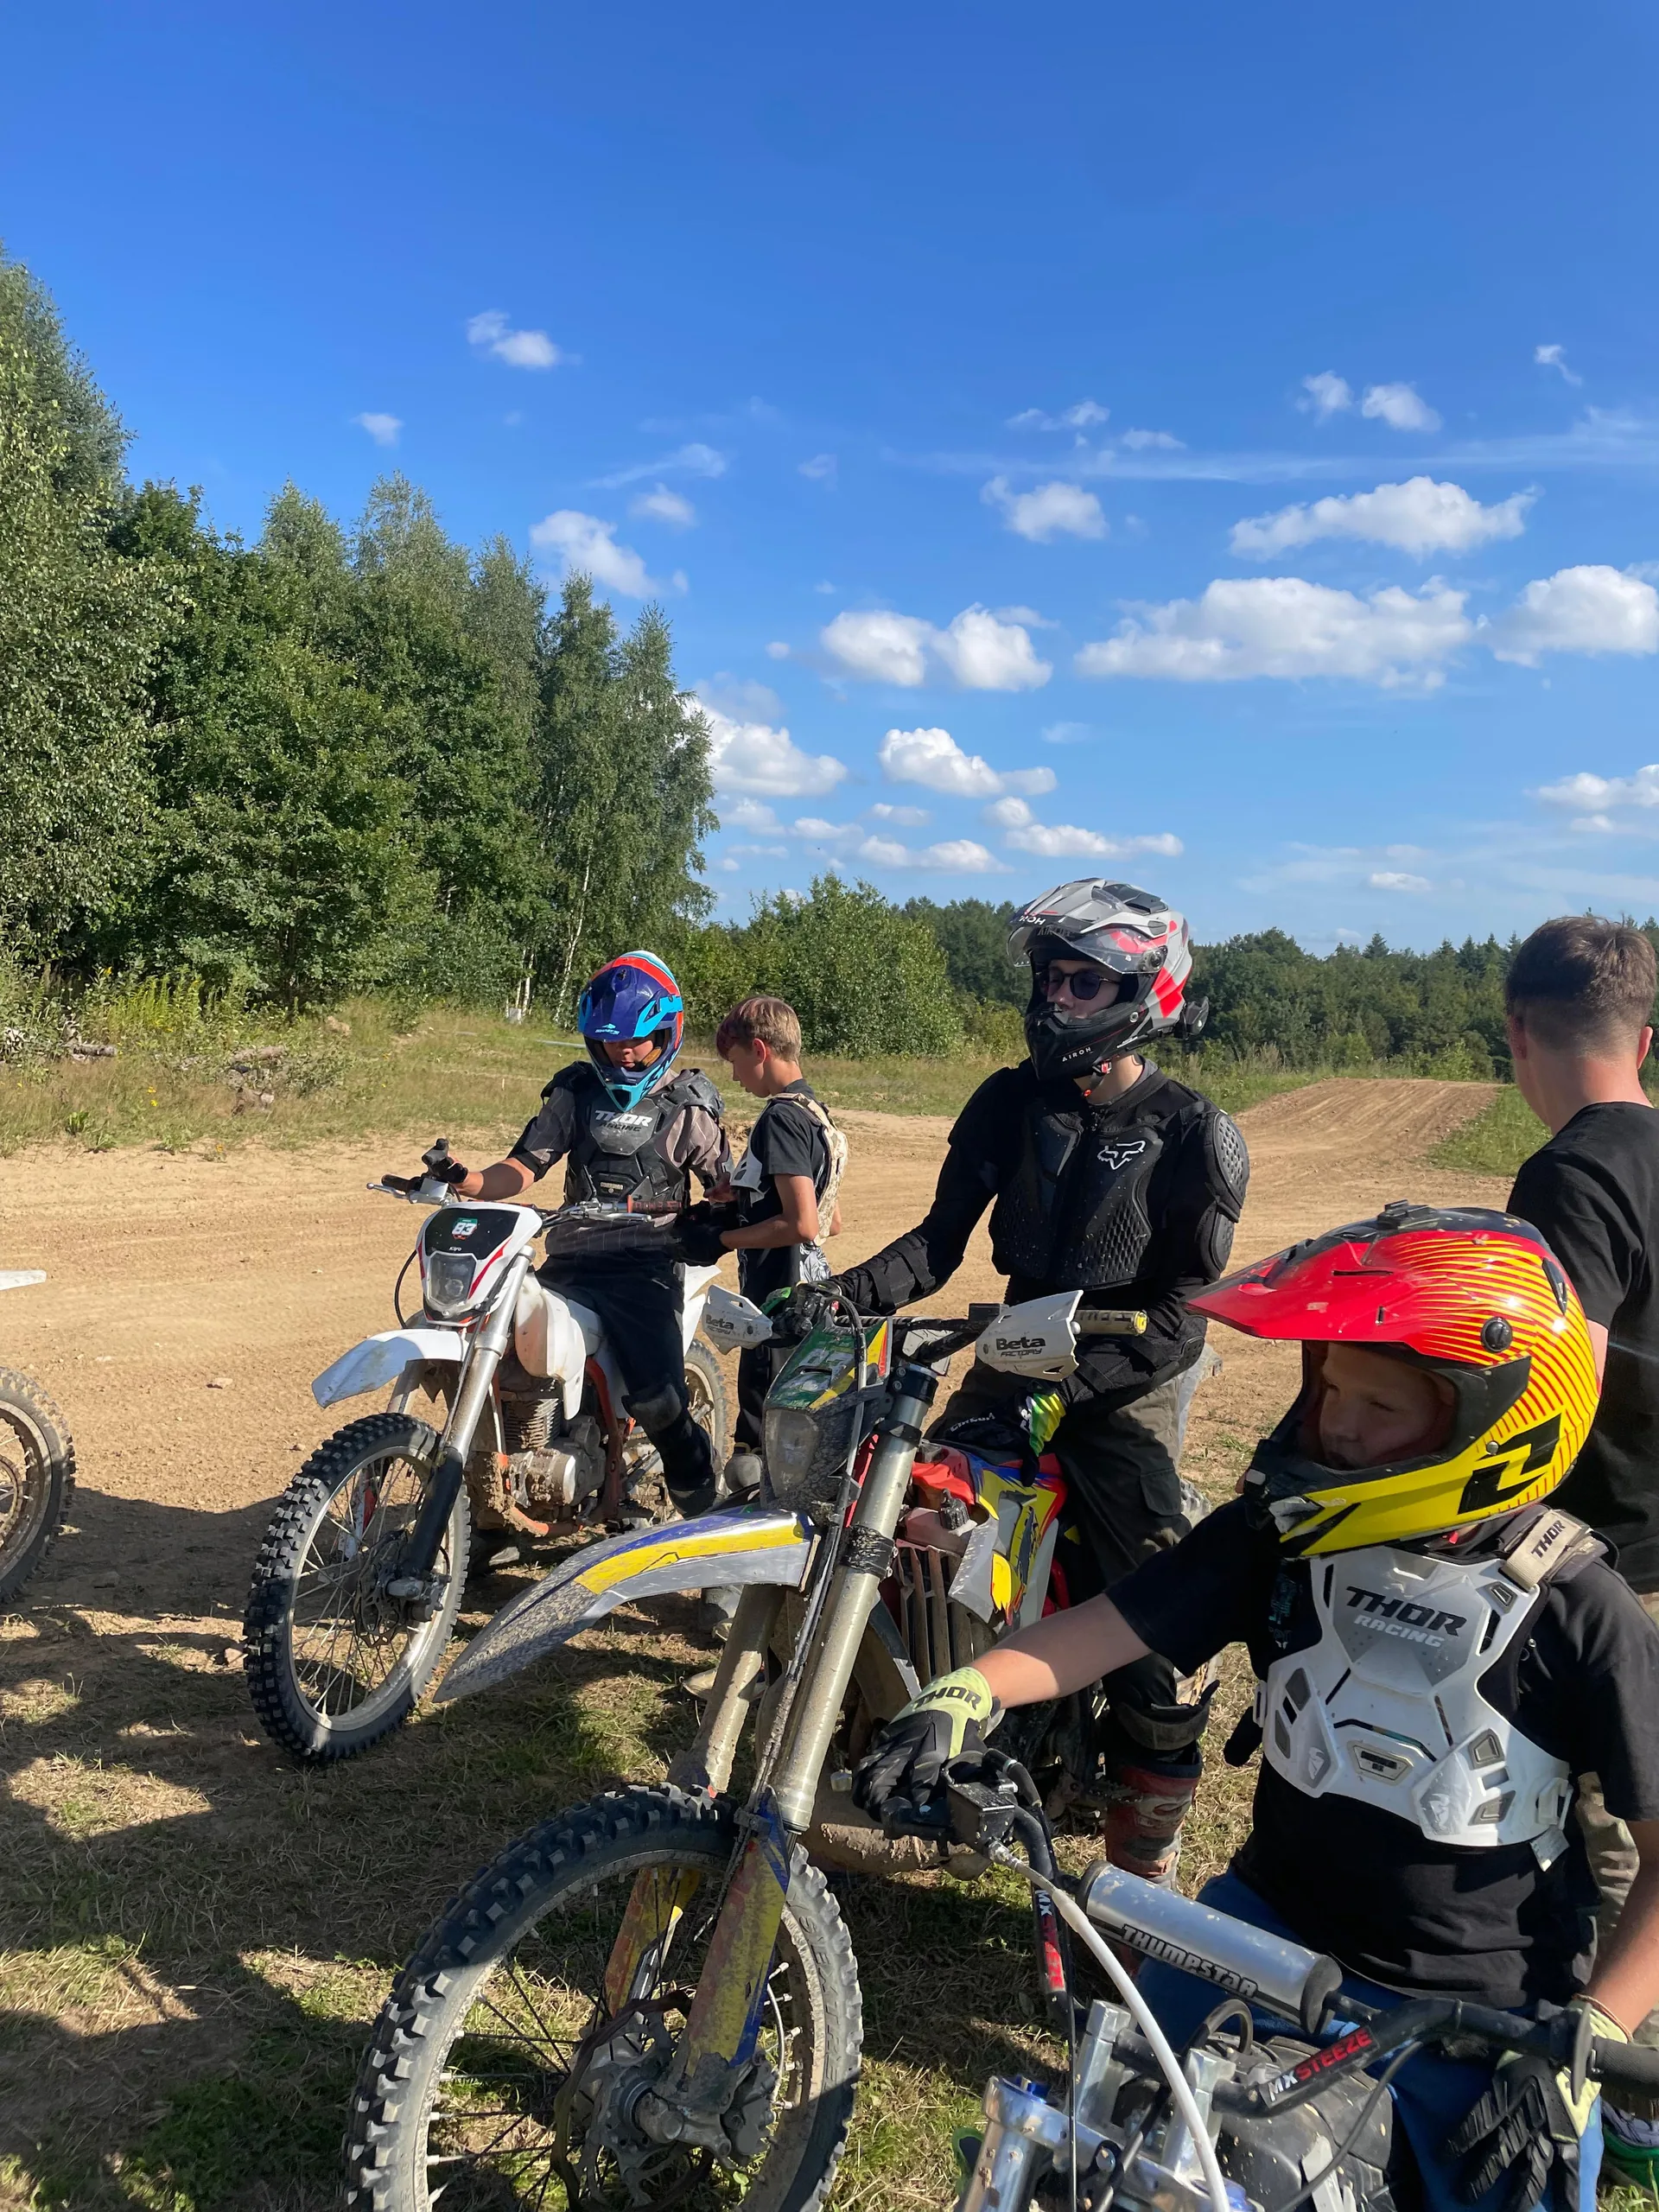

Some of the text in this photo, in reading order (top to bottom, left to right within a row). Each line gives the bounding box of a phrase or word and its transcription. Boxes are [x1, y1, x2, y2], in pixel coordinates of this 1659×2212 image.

[1061, 1046, 1092, 1063] AIROH
[594, 1109, 653, 1128] THOR
[705, 1313, 734, 1331] Beta
[995, 1336, 1046, 1351] Beta
[1000, 1348, 1043, 1357] FACTORY
[1530, 1519, 1567, 1559] THOR
[1345, 1586, 1468, 1637] THOR
[1353, 1614, 1446, 1648] RACING
[914, 1686, 982, 1711] THOR
[1122, 1924, 1257, 1999] THUMPSTAR
